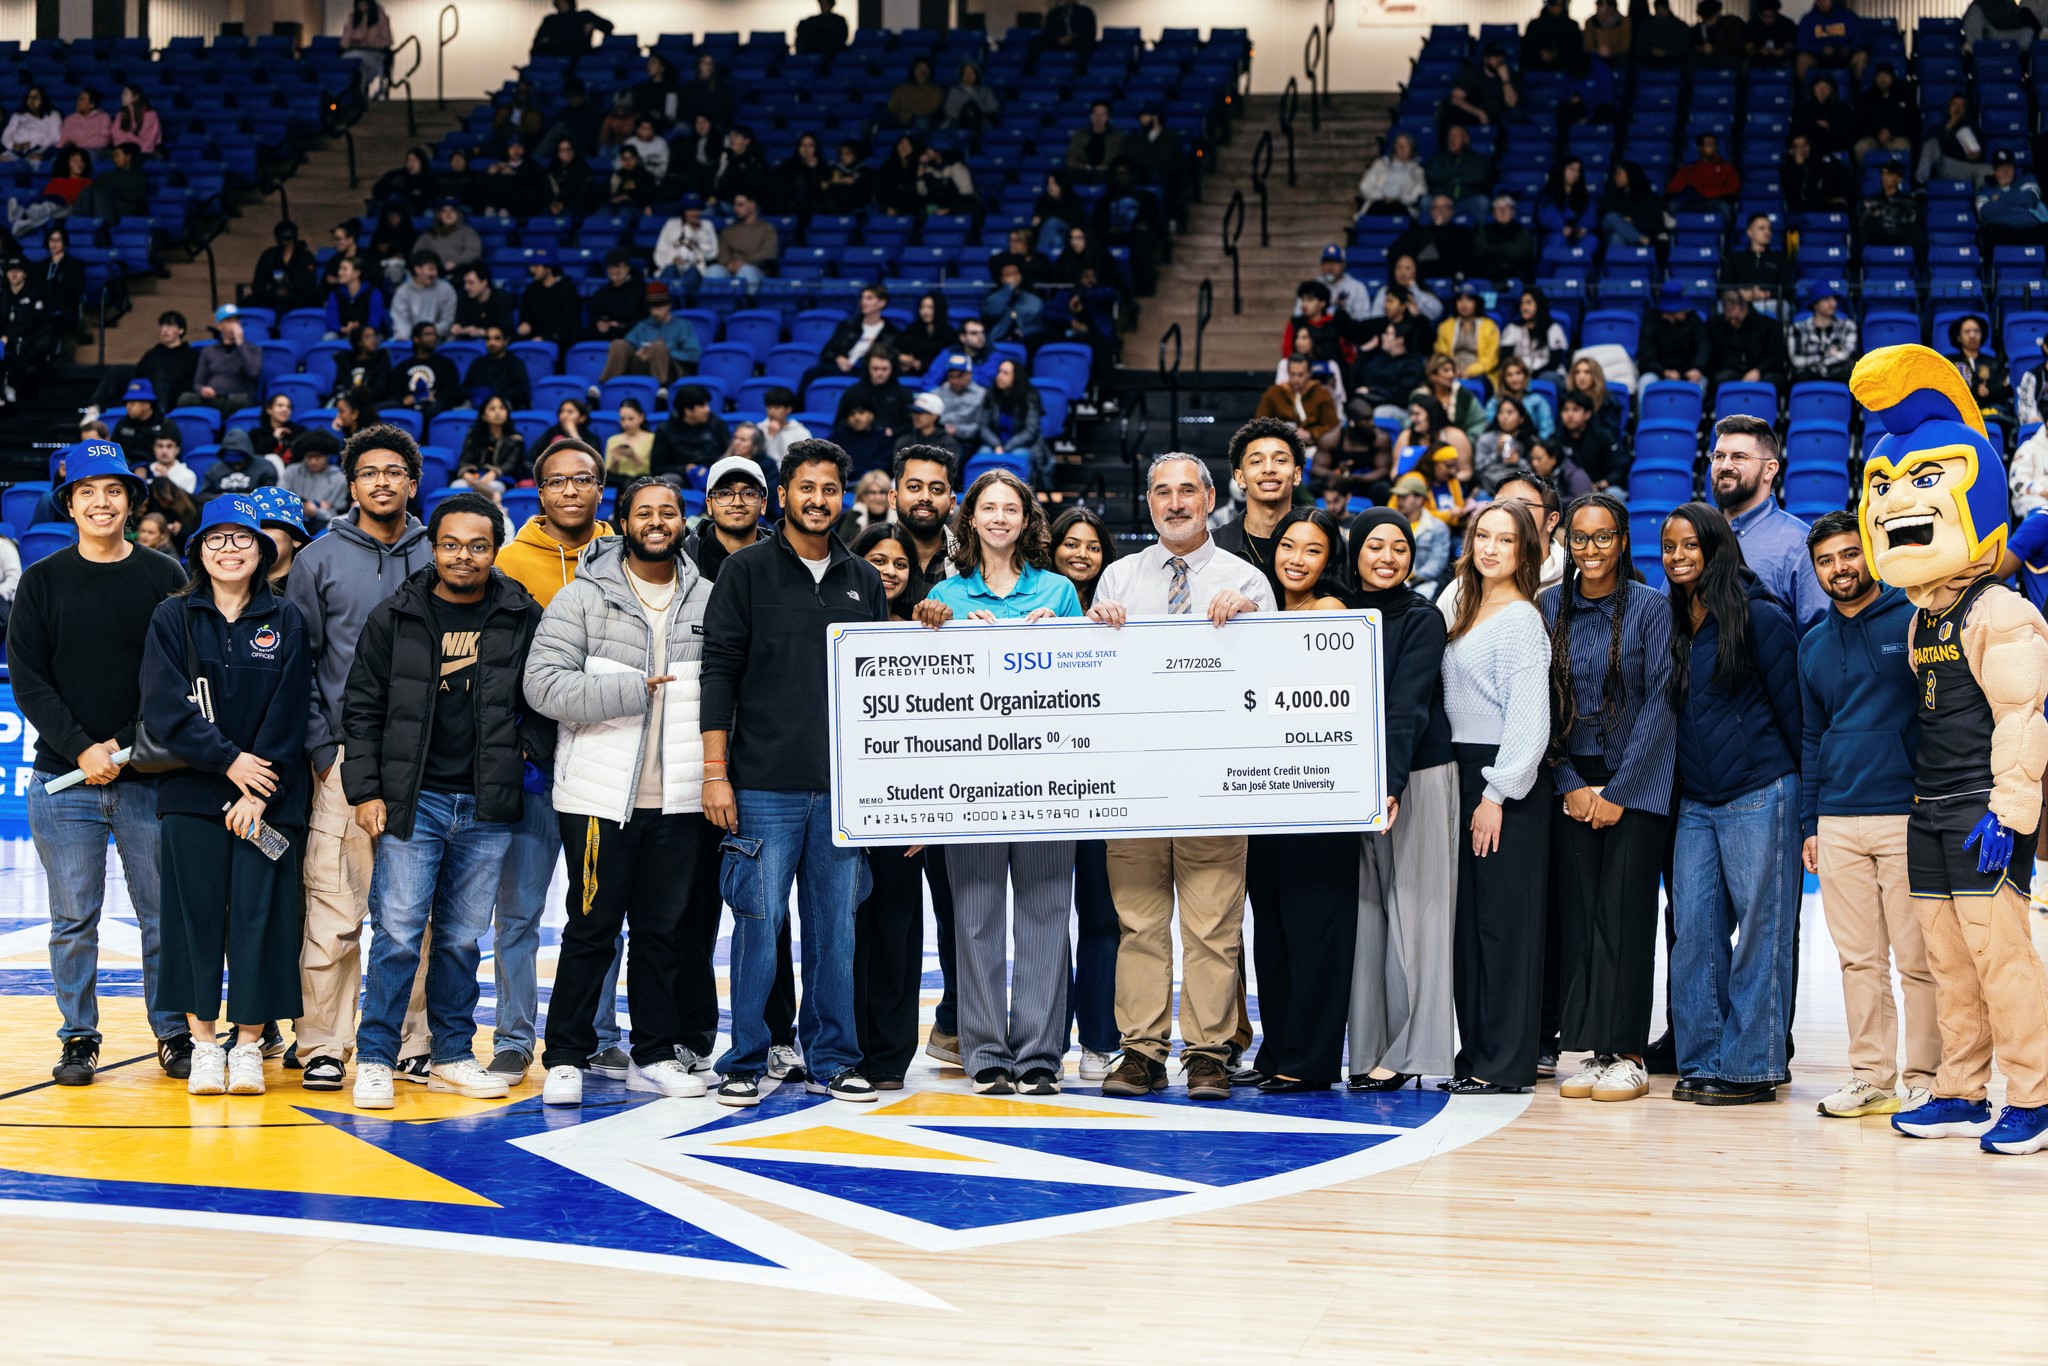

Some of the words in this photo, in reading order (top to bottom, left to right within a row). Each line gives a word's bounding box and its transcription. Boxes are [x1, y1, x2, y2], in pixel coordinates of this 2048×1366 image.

[88, 445, 117, 458] SJSU
[234, 500, 257, 520] SJSU
[441, 631, 481, 656] NIK
[1303, 632, 1354, 651] 1000
[251, 652, 275, 660] OFFICER
[878, 653, 974, 667] PROVIDENT
[1057, 651, 1074, 659] SAN
[1075, 649, 1093, 659] JOSÉ
[1095, 650, 1118, 658] STATE
[1913, 644, 1960, 665] PARTANS
[1003, 651, 1053, 674] SJSU
[1057, 660, 1103, 669] UNIVERSITY
[1165, 657, 1222, 670] 2/17/2026
[878, 667, 926, 677] CREDIT
[932, 666, 975, 676] UNION
[1925, 669, 1936, 709] 3
[862, 694, 900, 719] SJSU
[905, 692, 974, 714] Student
[979, 689, 1101, 716] Organizations
[1243, 689, 1257, 712] $
[1274, 689, 1350, 711] 4,000.00
[864, 736, 900, 755] Four
[904, 733, 983, 754] Thousand
[987, 732, 1043, 751] Dollars
[1285, 730, 1353, 744] DOLLARS
[1227, 766, 1271, 778] Provident
[1273, 765, 1301, 776] Credit
[1303, 764, 1330, 775] Union
[887, 783, 945, 801] Student
[949, 780, 1043, 803] Organization
[1048, 778, 1116, 800] Recipient
[1222, 780, 1230, 792] &
[1231, 780, 1247, 791] San
[1248, 779, 1267, 793] José
[1269, 779, 1290, 790] State
[1292, 778, 1335, 791] University
[859, 797, 884, 805] MEMO
